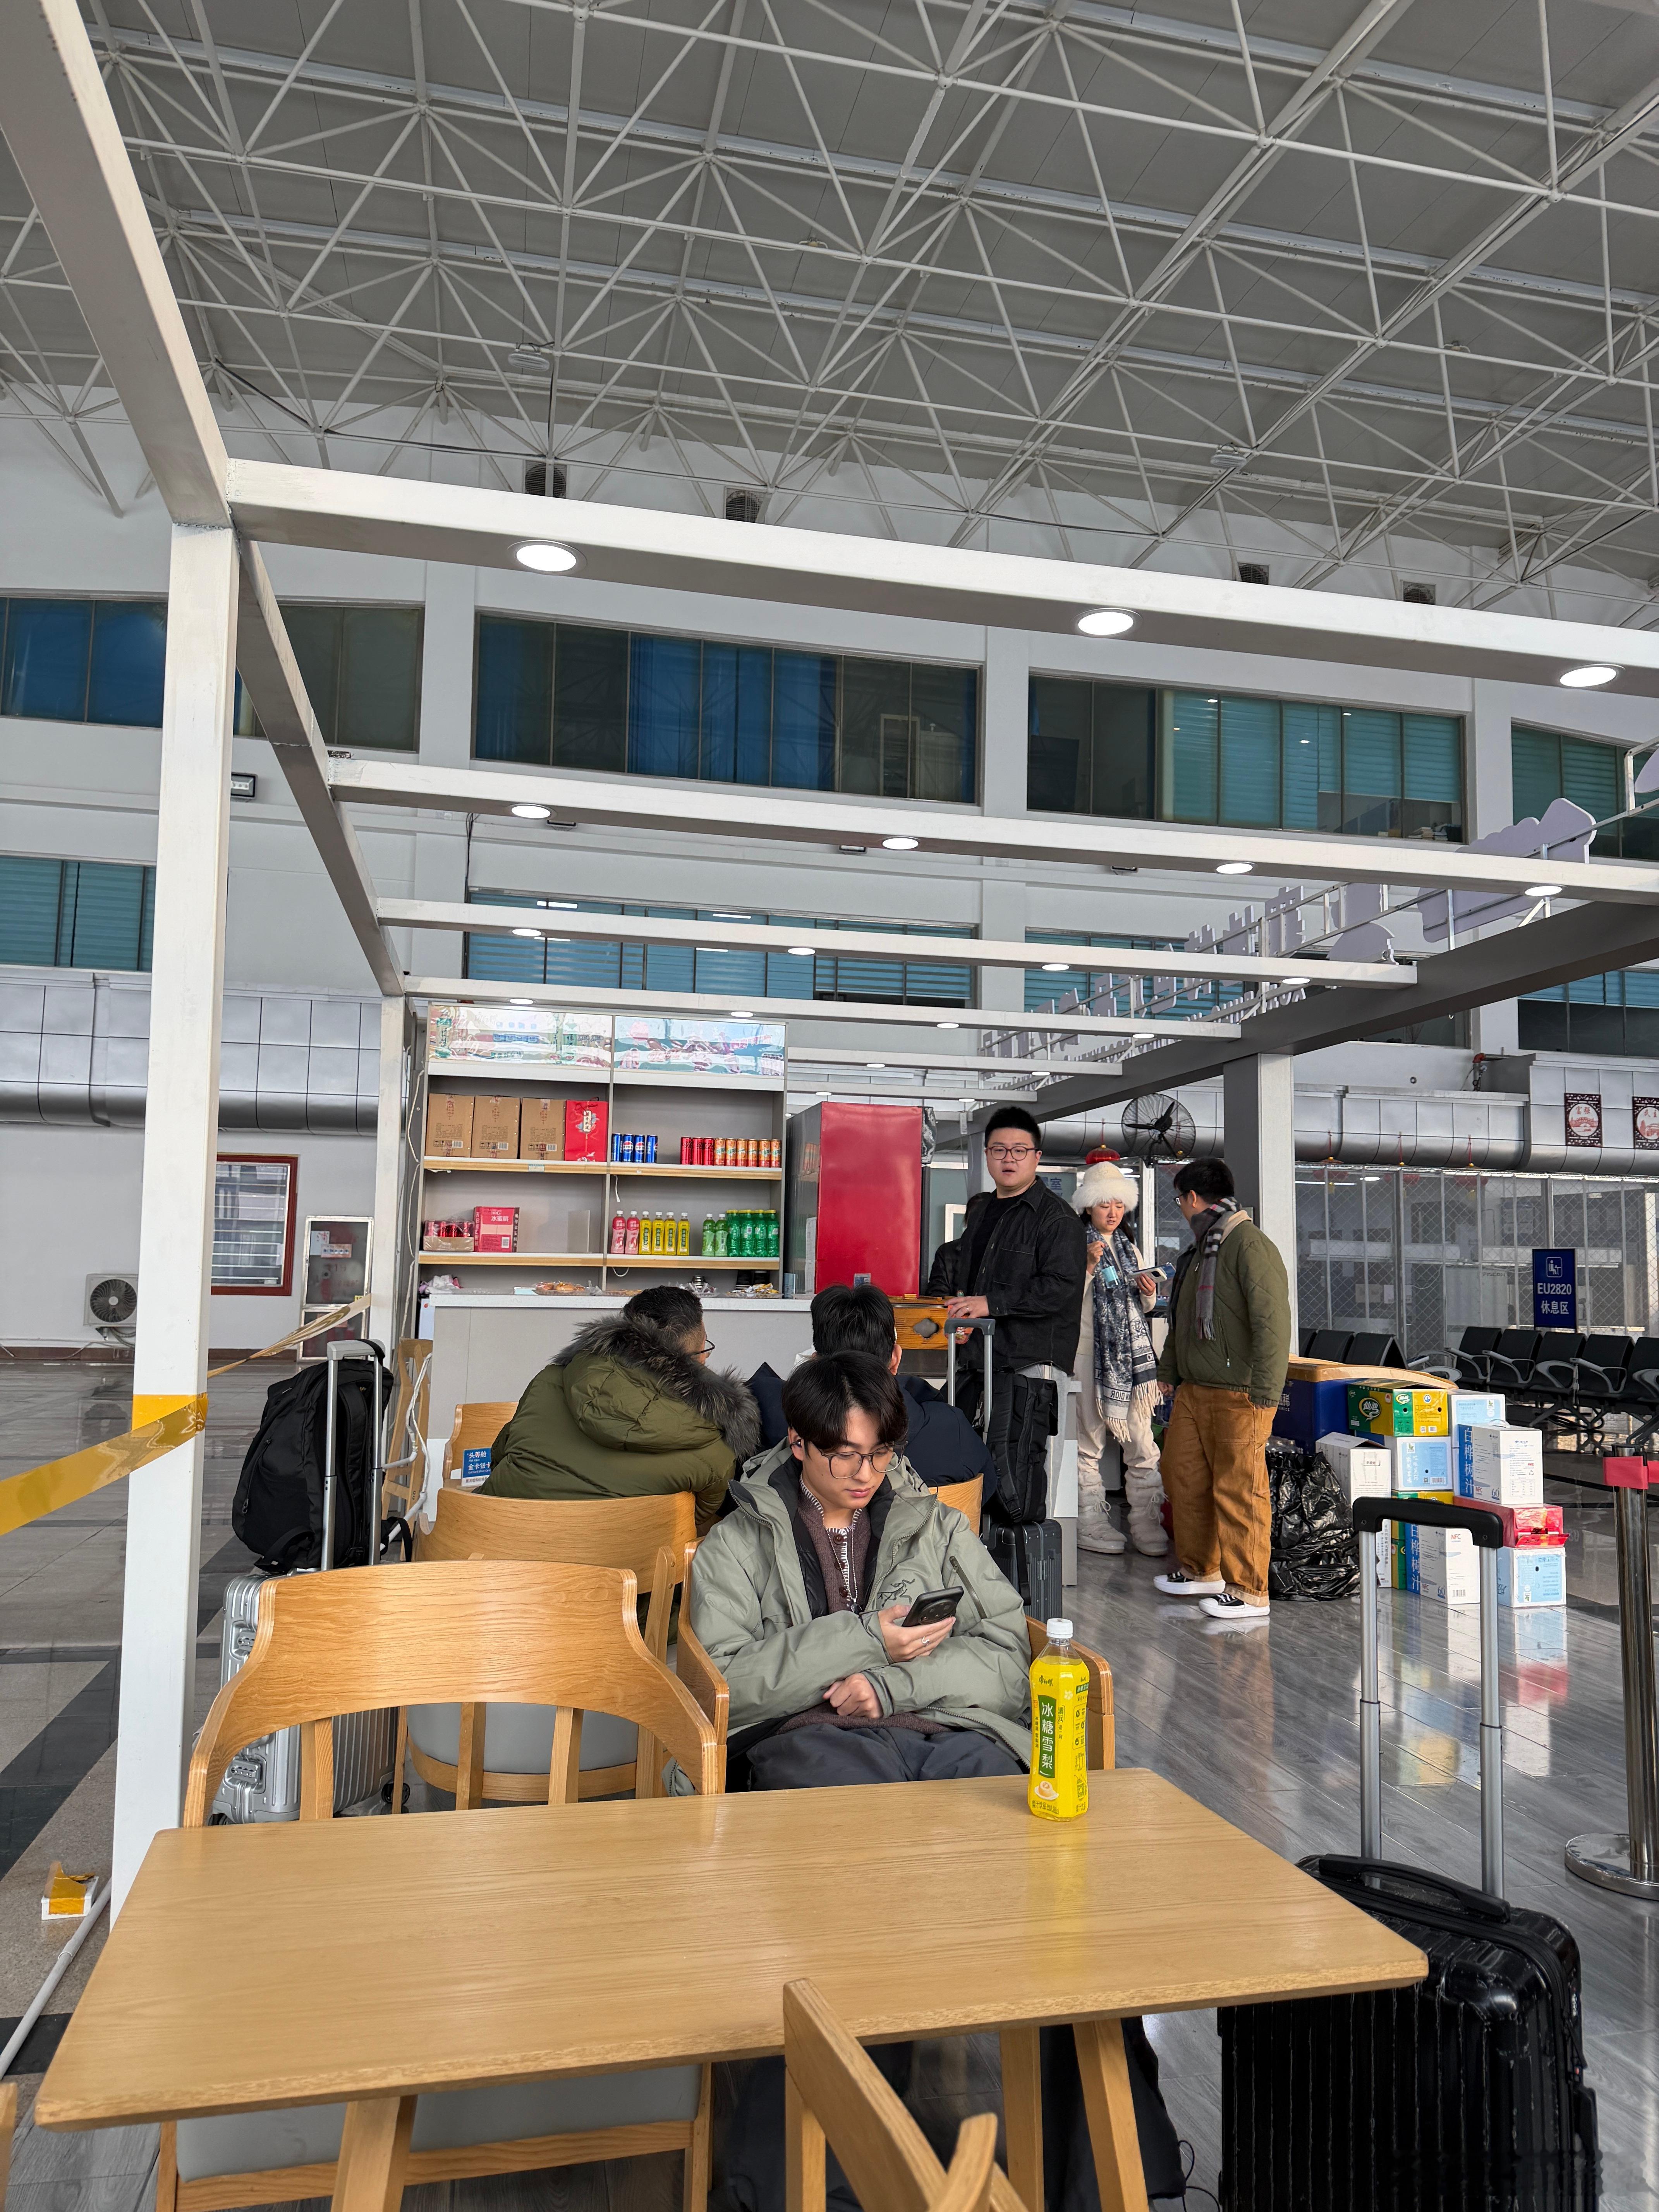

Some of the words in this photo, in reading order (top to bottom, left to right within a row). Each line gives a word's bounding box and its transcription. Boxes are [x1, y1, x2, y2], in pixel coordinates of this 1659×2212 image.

[1575, 1106, 1591, 1115] 富强
[1644, 1109, 1658, 1118] 民主
[1537, 1283, 1572, 1295] EU2820
[1541, 1300, 1570, 1314] 休息区
[469, 1451, 486, 1459] 头等舱
[1465, 1427, 1474, 1494] 白桦树汁
[1041, 1702, 1053, 1769] 冰糖雪梨
